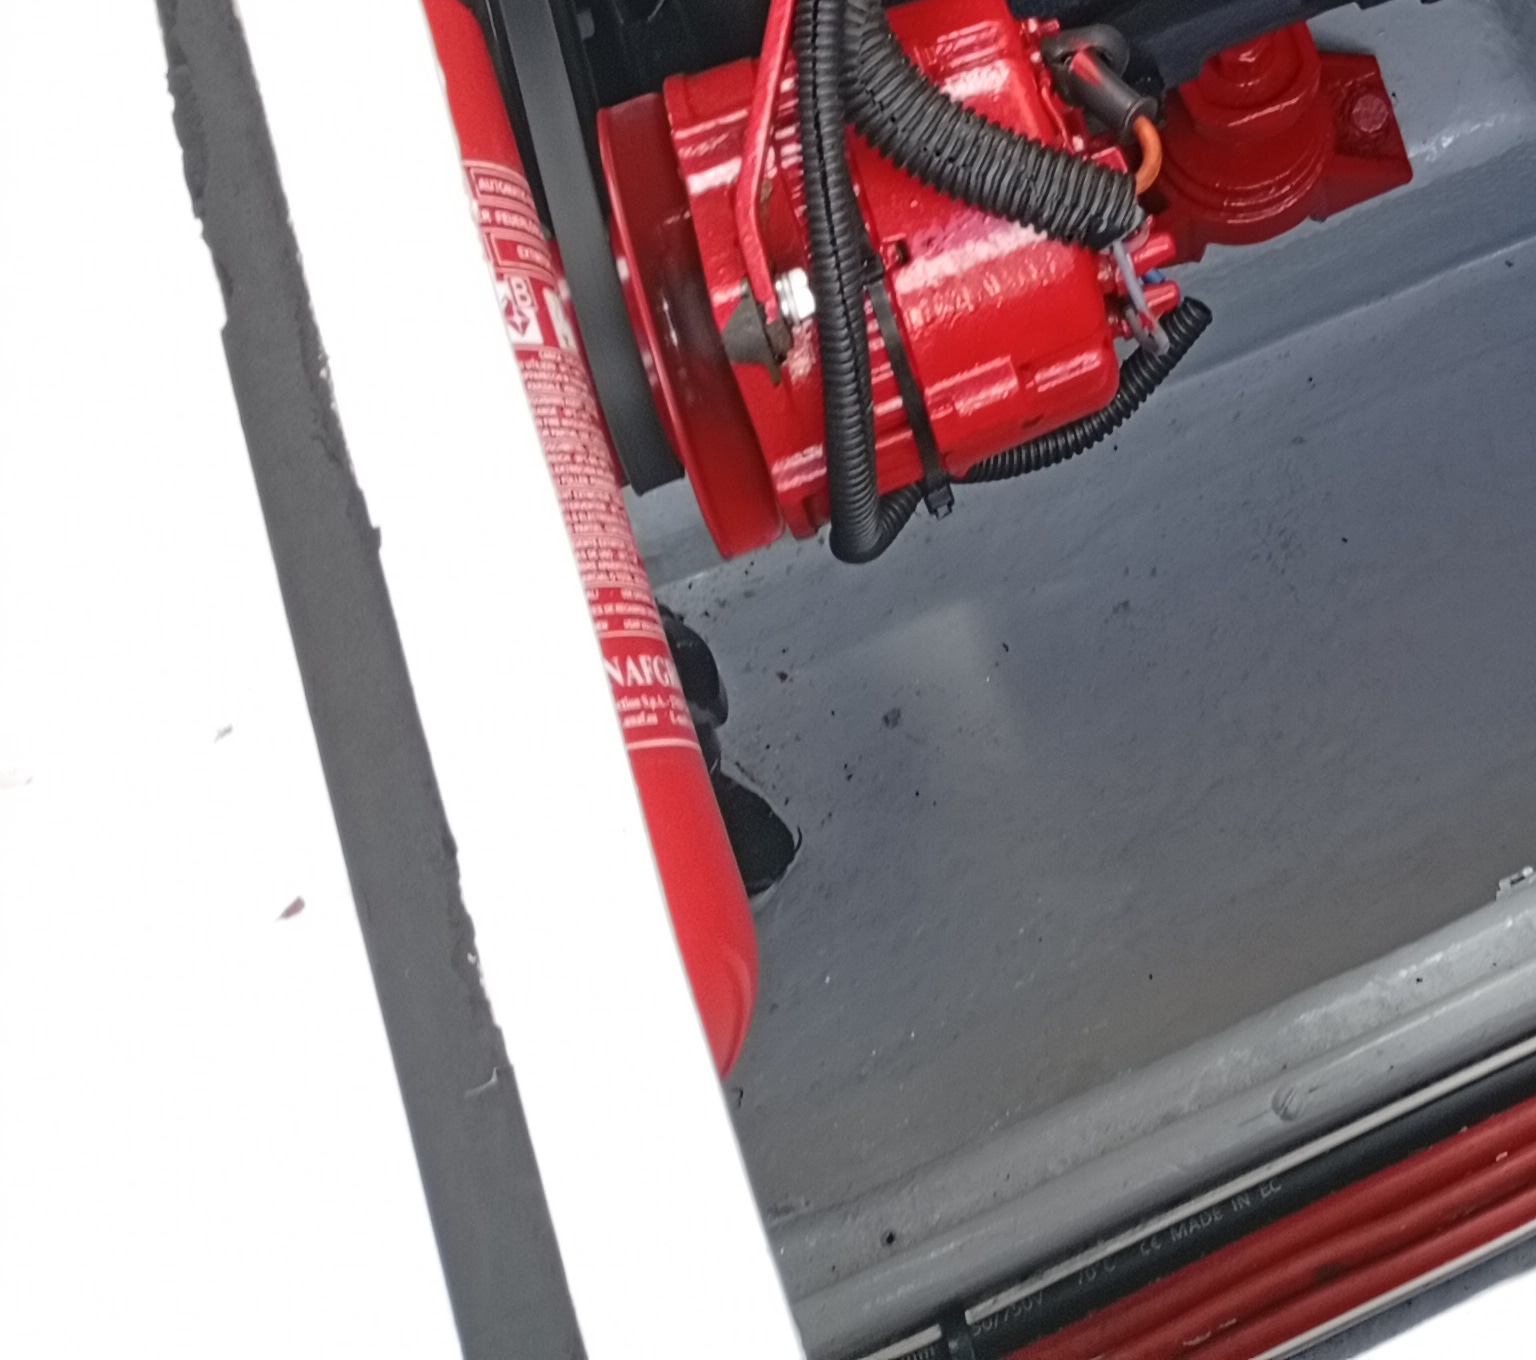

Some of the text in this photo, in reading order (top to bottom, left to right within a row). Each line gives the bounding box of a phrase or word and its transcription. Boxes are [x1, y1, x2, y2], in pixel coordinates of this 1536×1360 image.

[1170, 1211, 1224, 1243] MADE
[1231, 1196, 1251, 1212] IN
[1258, 1181, 1282, 1200] EC
